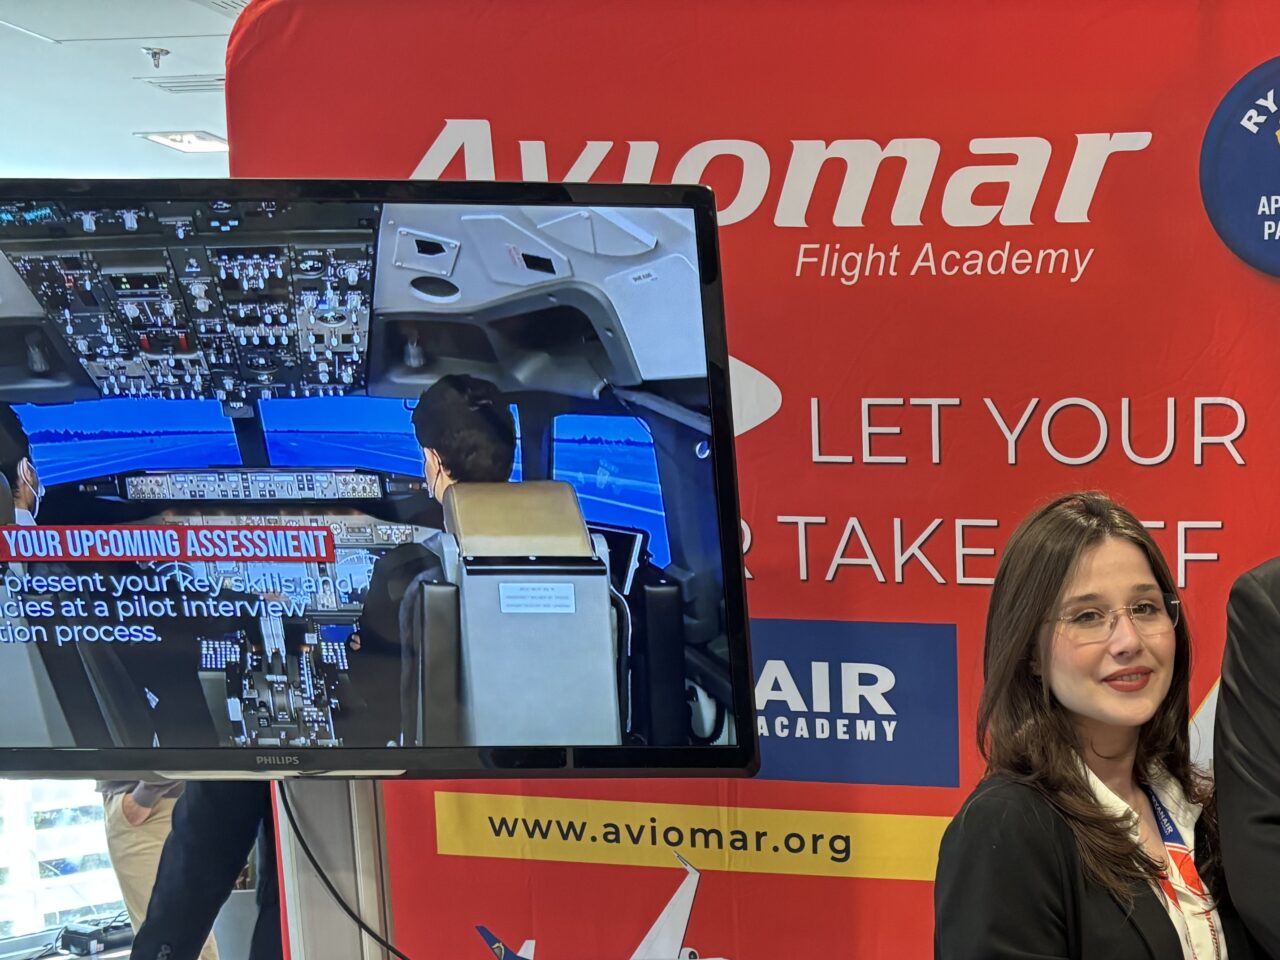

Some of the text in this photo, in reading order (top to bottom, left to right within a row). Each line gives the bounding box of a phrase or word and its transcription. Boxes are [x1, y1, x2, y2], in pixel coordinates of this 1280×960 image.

[795, 242, 1094, 285] Flight Academy
[810, 396, 1247, 466] LET YOUR
[3, 529, 328, 558] YOUR UPCOMING ASSESSMENT
[777, 515, 999, 586] TAKE
[4, 572, 351, 597] present your key skills and
[60, 598, 88, 617] at
[94, 602, 110, 617] a
[116, 597, 177, 620] pilot
[182, 597, 308, 618] interview
[56, 625, 162, 646] process.
[754, 660, 897, 716] AIR
[757, 716, 897, 742] ACADEMY
[256, 756, 300, 765] PHILIPS
[488, 815, 853, 863] www.aviomar.org
